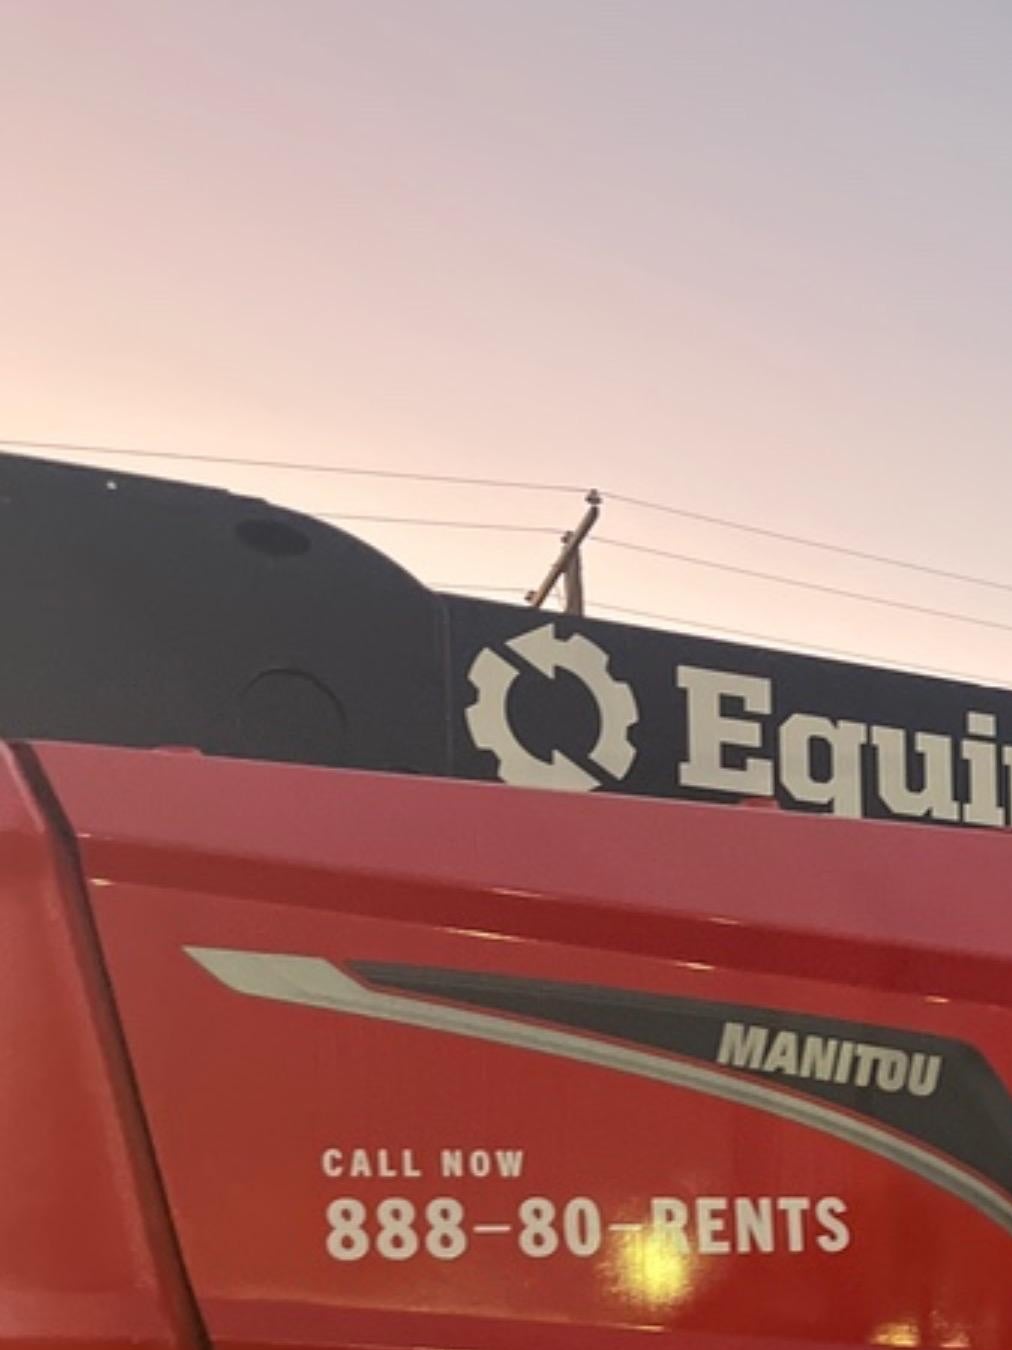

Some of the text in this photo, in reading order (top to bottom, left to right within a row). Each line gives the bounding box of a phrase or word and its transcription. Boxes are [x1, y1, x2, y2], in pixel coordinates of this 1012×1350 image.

[716, 1021, 943, 1097] MANITOU
[321, 1148, 524, 1178] CALL NOW
[325, 1197, 851, 1261] 888-80-RENTS
